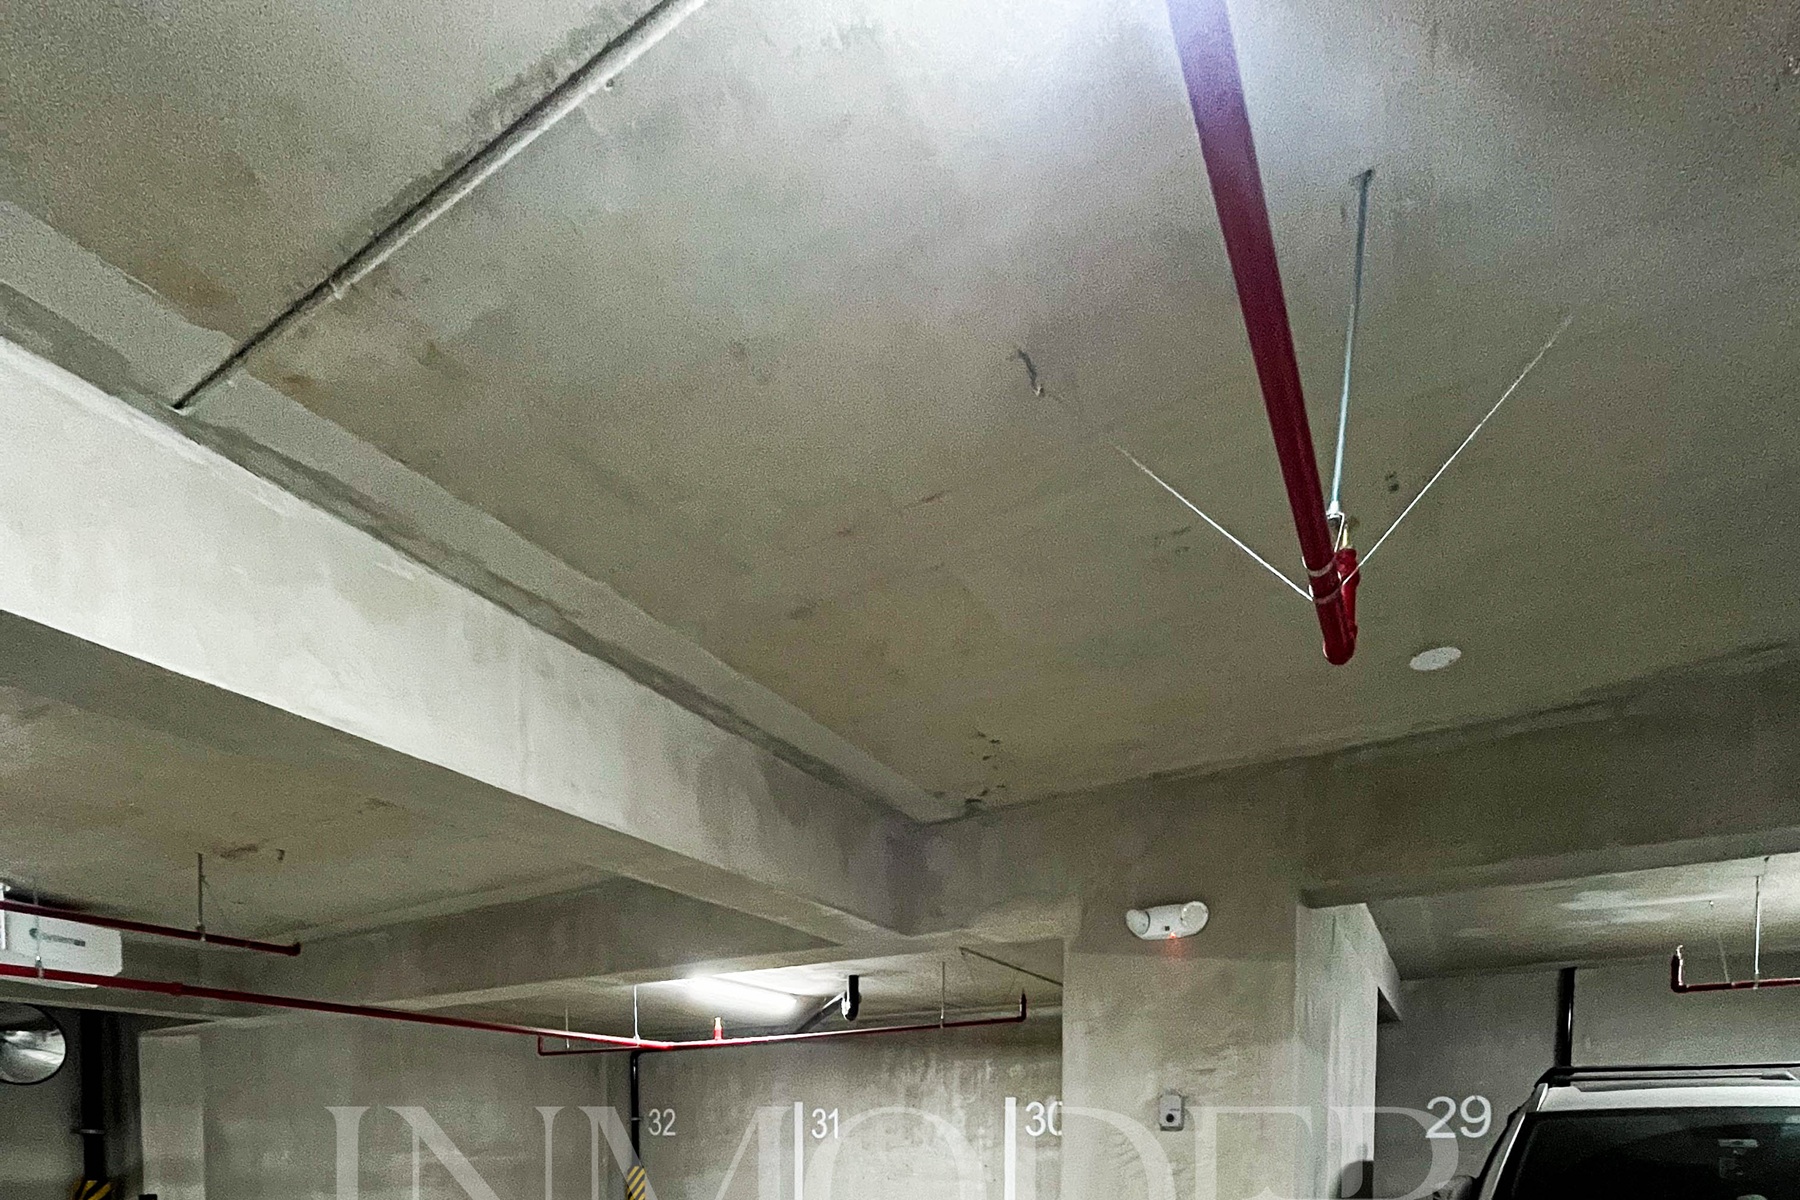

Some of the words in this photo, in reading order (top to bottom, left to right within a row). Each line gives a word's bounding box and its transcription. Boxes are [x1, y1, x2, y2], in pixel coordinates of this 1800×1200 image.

[648, 1108, 676, 1136] 32
[811, 1107, 839, 1139] 31
[1025, 1101, 1063, 1137] 30
[1425, 1095, 1492, 1138] 29
